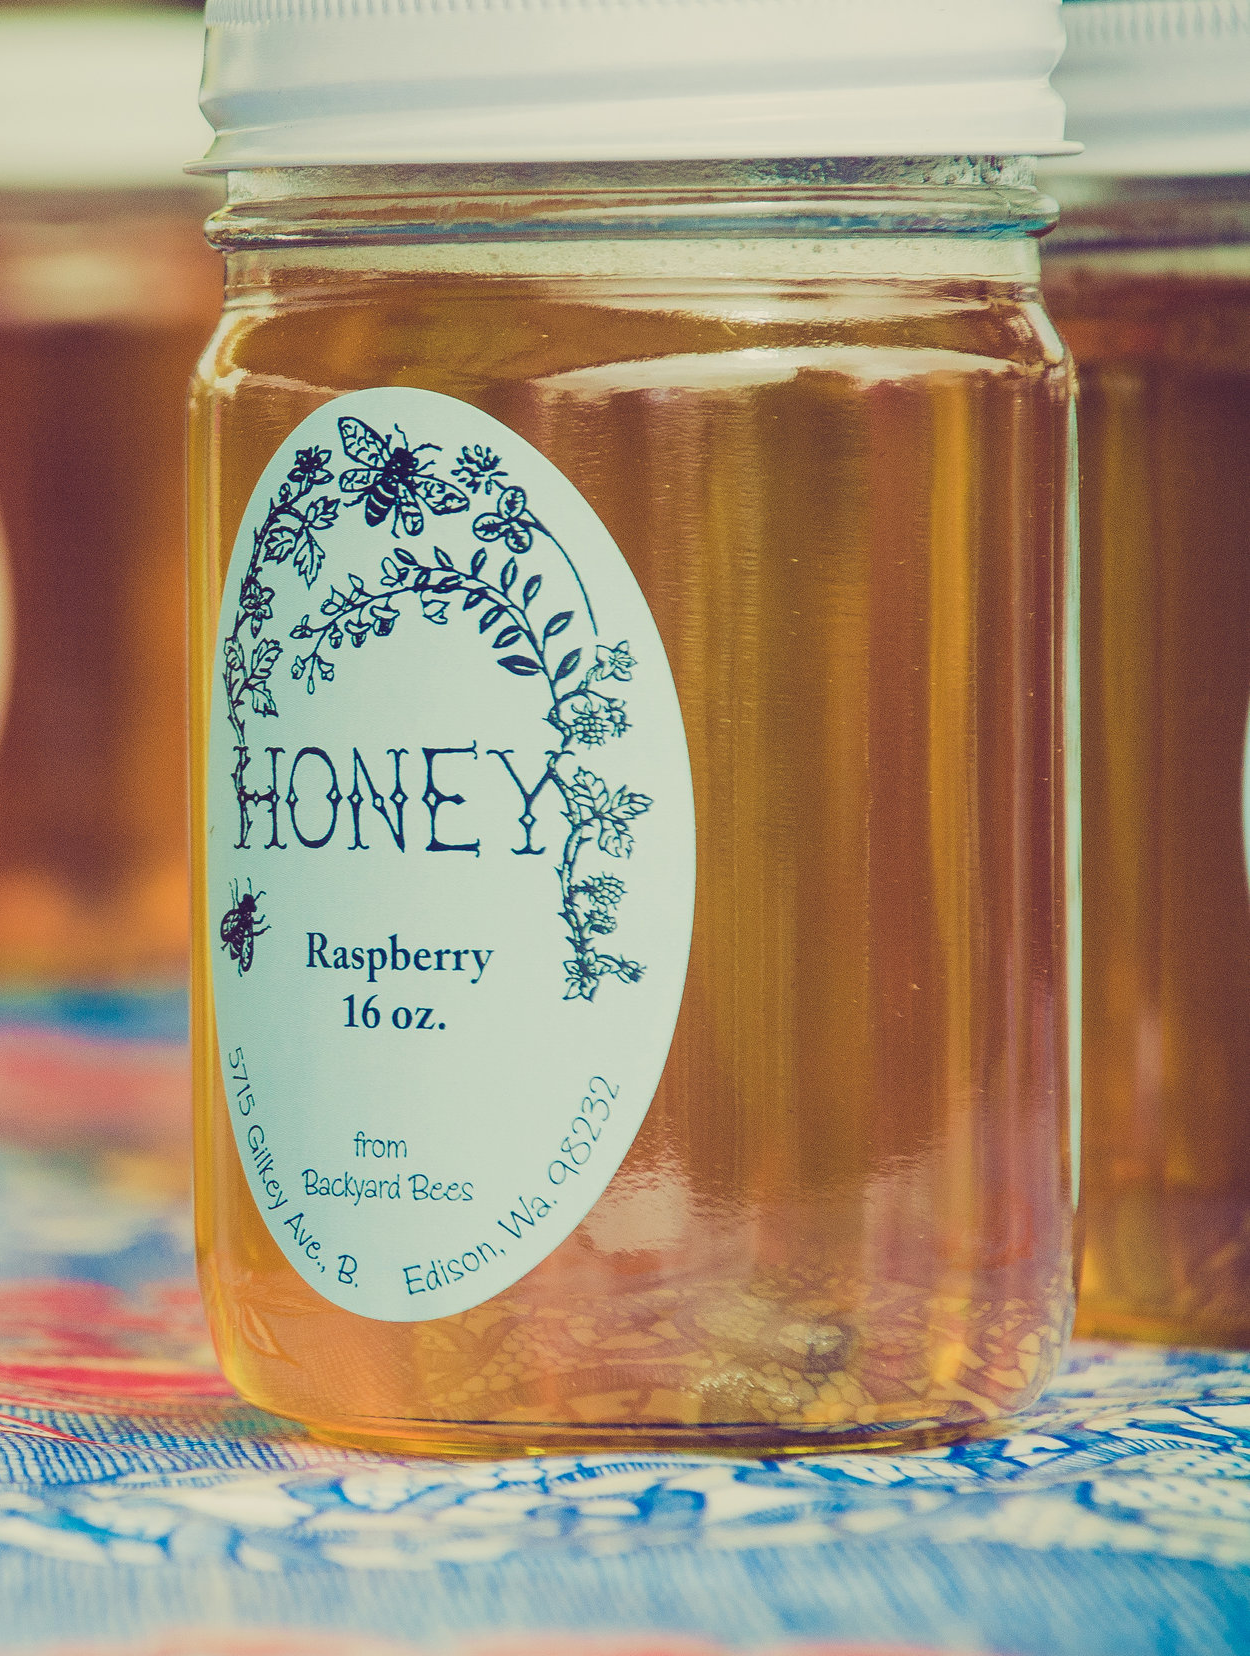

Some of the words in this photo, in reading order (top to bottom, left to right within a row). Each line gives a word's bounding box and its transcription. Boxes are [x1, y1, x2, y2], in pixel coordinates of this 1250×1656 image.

[234, 740, 575, 858] HONEY
[306, 931, 495, 985] Raspberry
[342, 993, 382, 1029] 16
[391, 1006, 447, 1031] oz.
[229, 1047, 256, 1117] 5715
[248, 1125, 289, 1211] Gilkey
[284, 1212, 326, 1273] Ave.,
[337, 1255, 359, 1288] B.
[353, 1130, 408, 1159] from
[301, 1167, 401, 1207] Backyard
[407, 1173, 475, 1202] Bees
[402, 1242, 507, 1295] Edison,
[498, 1196, 558, 1239] Wa.
[548, 1076, 620, 1185] 98232
